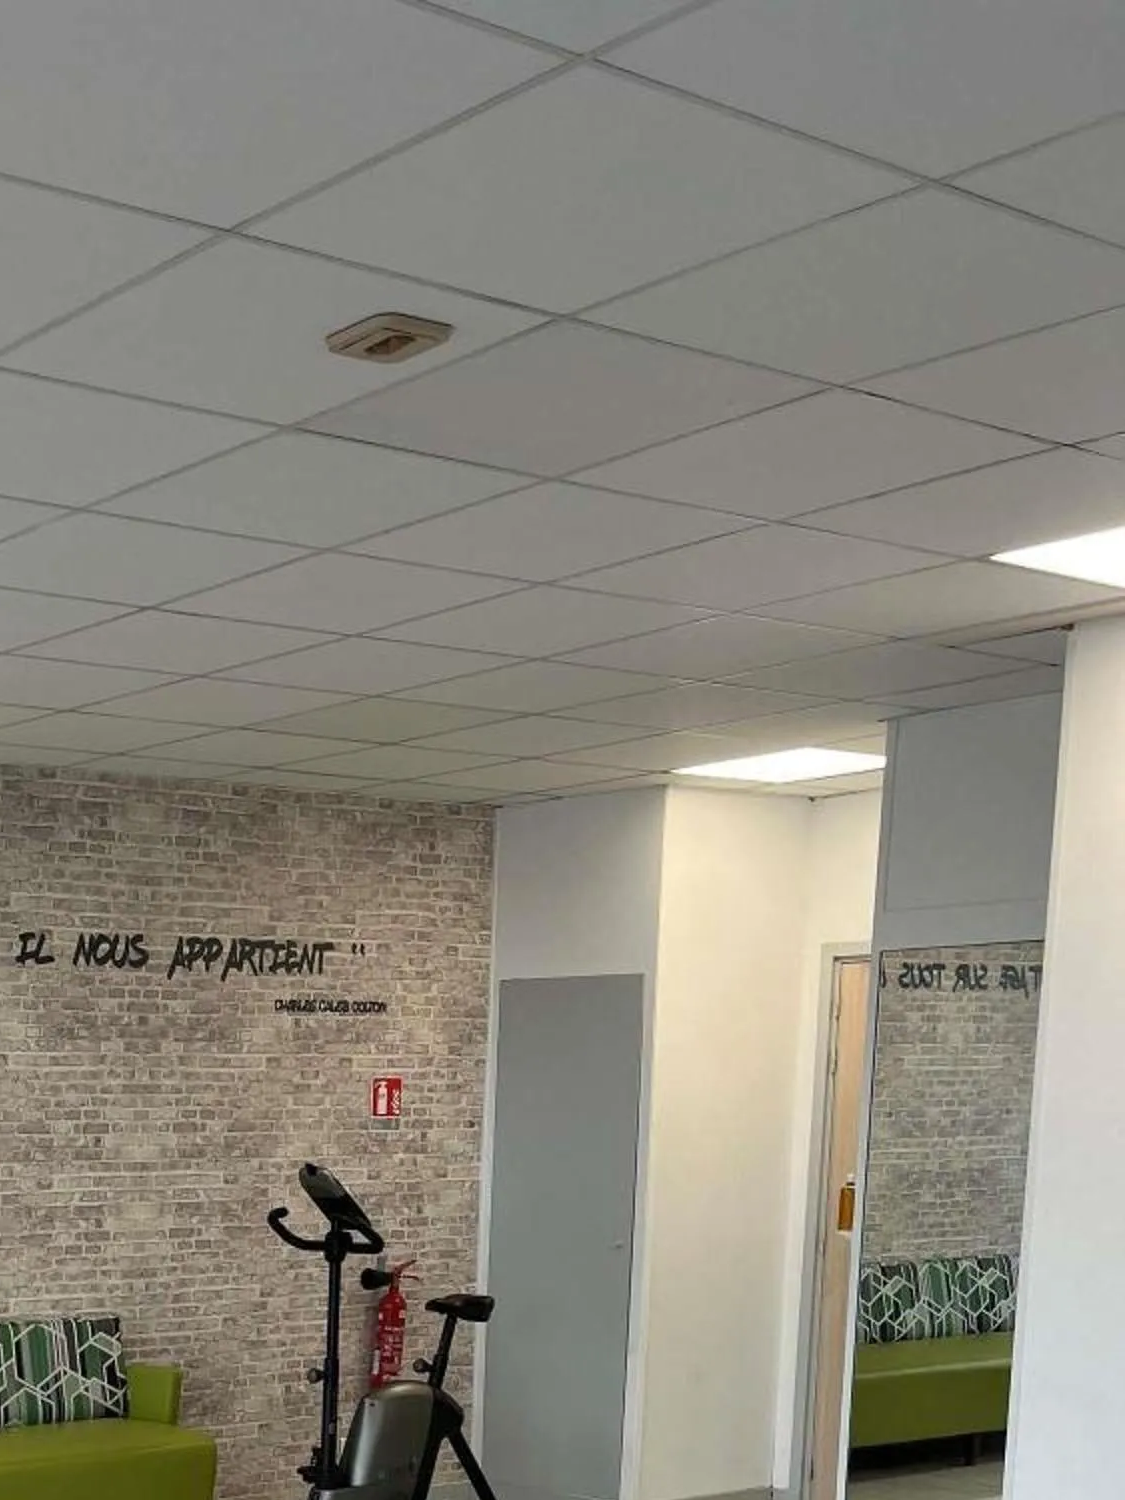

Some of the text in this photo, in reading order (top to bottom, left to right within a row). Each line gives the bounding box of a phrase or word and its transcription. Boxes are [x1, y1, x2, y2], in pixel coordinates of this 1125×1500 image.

[14, 931, 56, 966] IL
[72, 932, 150, 969] NOUS
[166, 935, 334, 981] APPARTIENT
